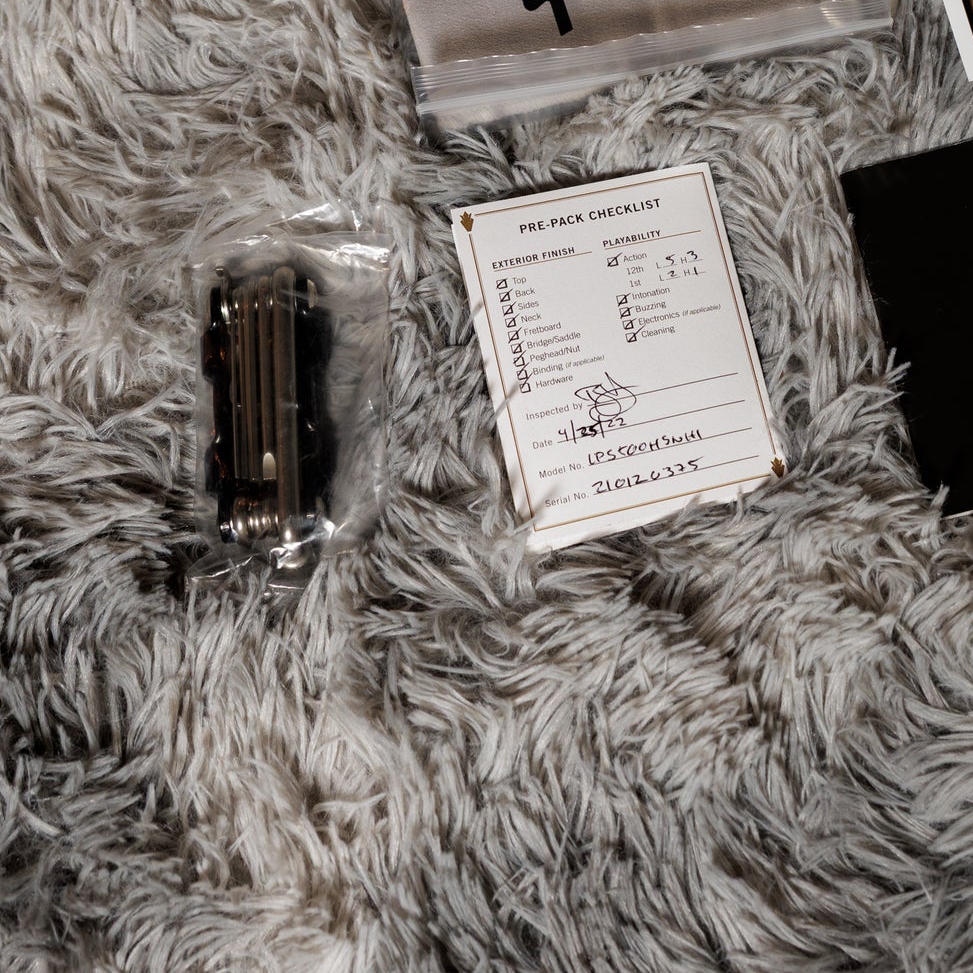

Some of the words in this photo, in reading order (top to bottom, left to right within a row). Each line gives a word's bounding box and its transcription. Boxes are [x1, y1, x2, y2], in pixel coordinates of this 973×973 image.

[519, 213, 585, 234] PRE-PACK
[588, 198, 661, 221] CHECKLIST
[602, 229, 661, 248] PLAYABILITY
[491, 253, 540, 270] EXTERIOR
[541, 246, 576, 260] FINISH
[623, 252, 648, 263] Action
[626, 265, 644, 276] 12th
[680, 256, 688, 264] H
[511, 276, 527, 286] Top
[629, 279, 642, 288] 1st
[683, 268, 691, 277] H
[514, 287, 536, 298] Back
[631, 286, 671, 301] Intonation
[517, 300, 540, 311] Sides
[634, 301, 667, 314] Buzzing
[520, 313, 542, 323] Neck
[637, 311, 681, 326] Electronics
[523, 321, 562, 336] Fretboard
[641, 325, 676, 339] Cleaning
[526, 331, 581, 350] Bridge/Saddle
[529, 344, 581, 363] Peghead/Nut
[532, 362, 564, 376] Binding
[535, 373, 574, 389] Hardware
[525, 403, 570, 421] Inspected
[572, 402, 583, 411] by
[532, 438, 553, 450] Date
[538, 465, 566, 479] Model
[568, 462, 585, 472] No.
[544, 494, 570, 508] Serial
[573, 491, 589, 501] No.
